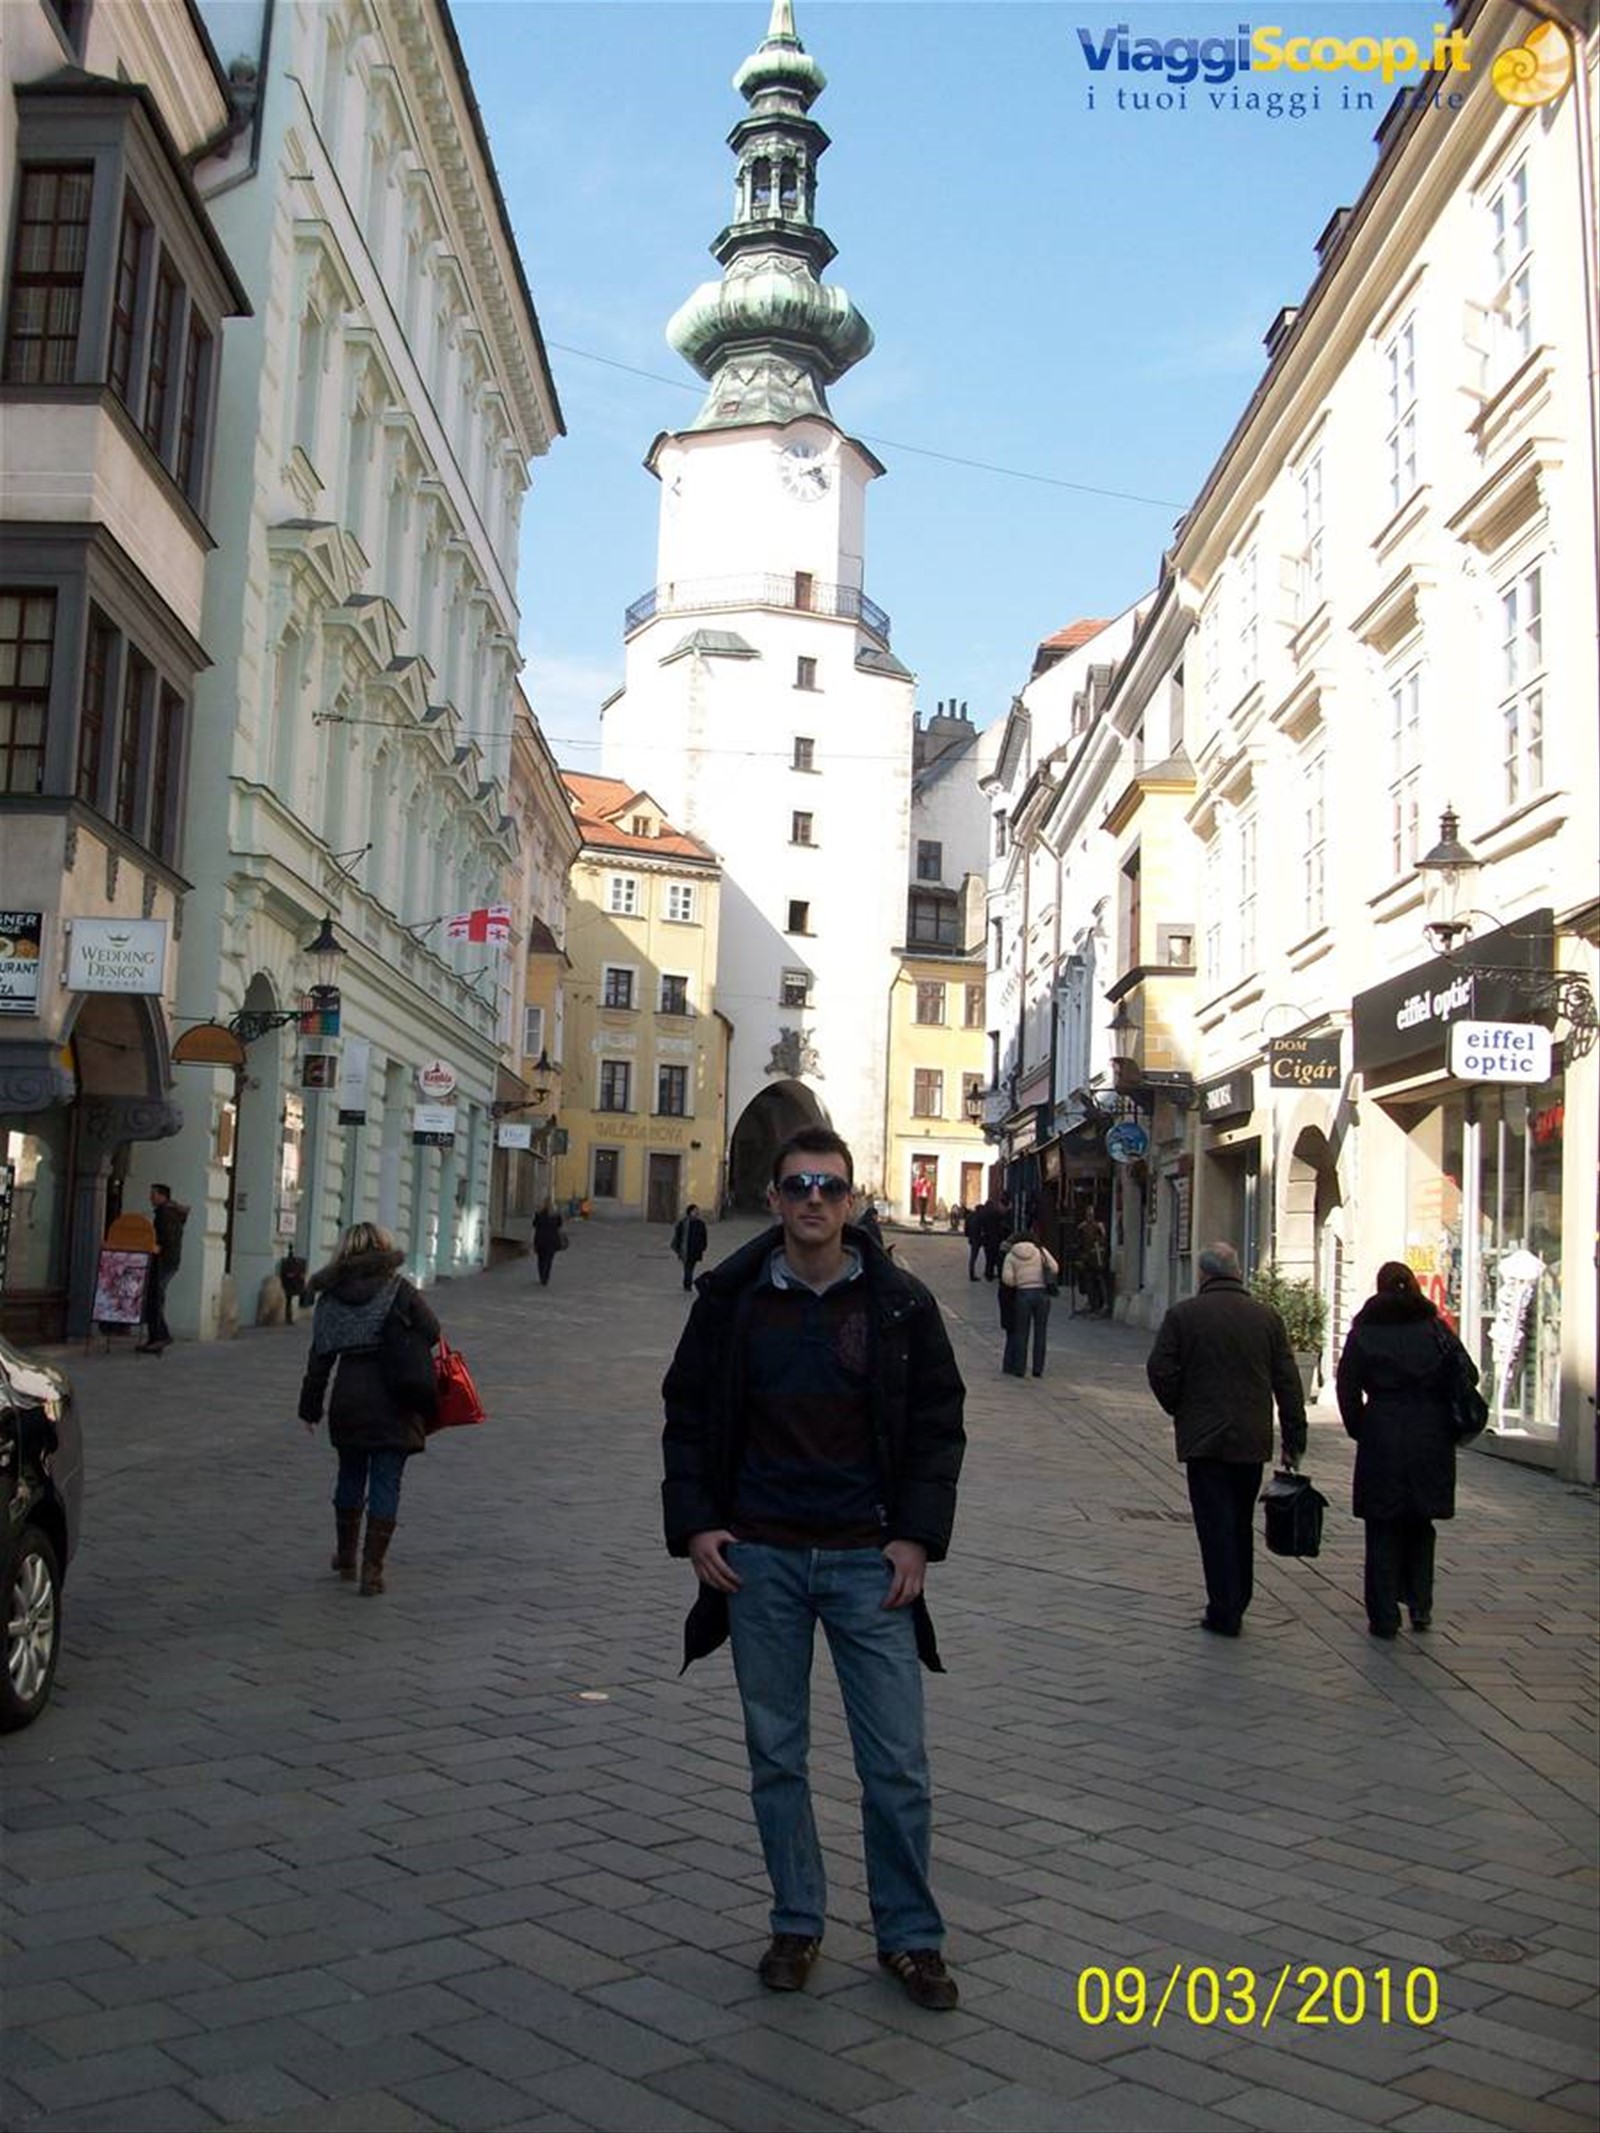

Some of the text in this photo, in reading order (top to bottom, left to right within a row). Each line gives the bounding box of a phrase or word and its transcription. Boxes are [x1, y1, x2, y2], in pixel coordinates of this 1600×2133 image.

[82, 946, 155, 965] WEDDING
[88, 962, 144, 979] DESIGN
[1397, 989, 1432, 1030] eiffel
[1273, 1040, 1308, 1051] DOM
[1467, 1030, 1534, 1051] eiffel
[1273, 1058, 1337, 1085] Cigár
[1464, 1053, 1533, 1075] optic
